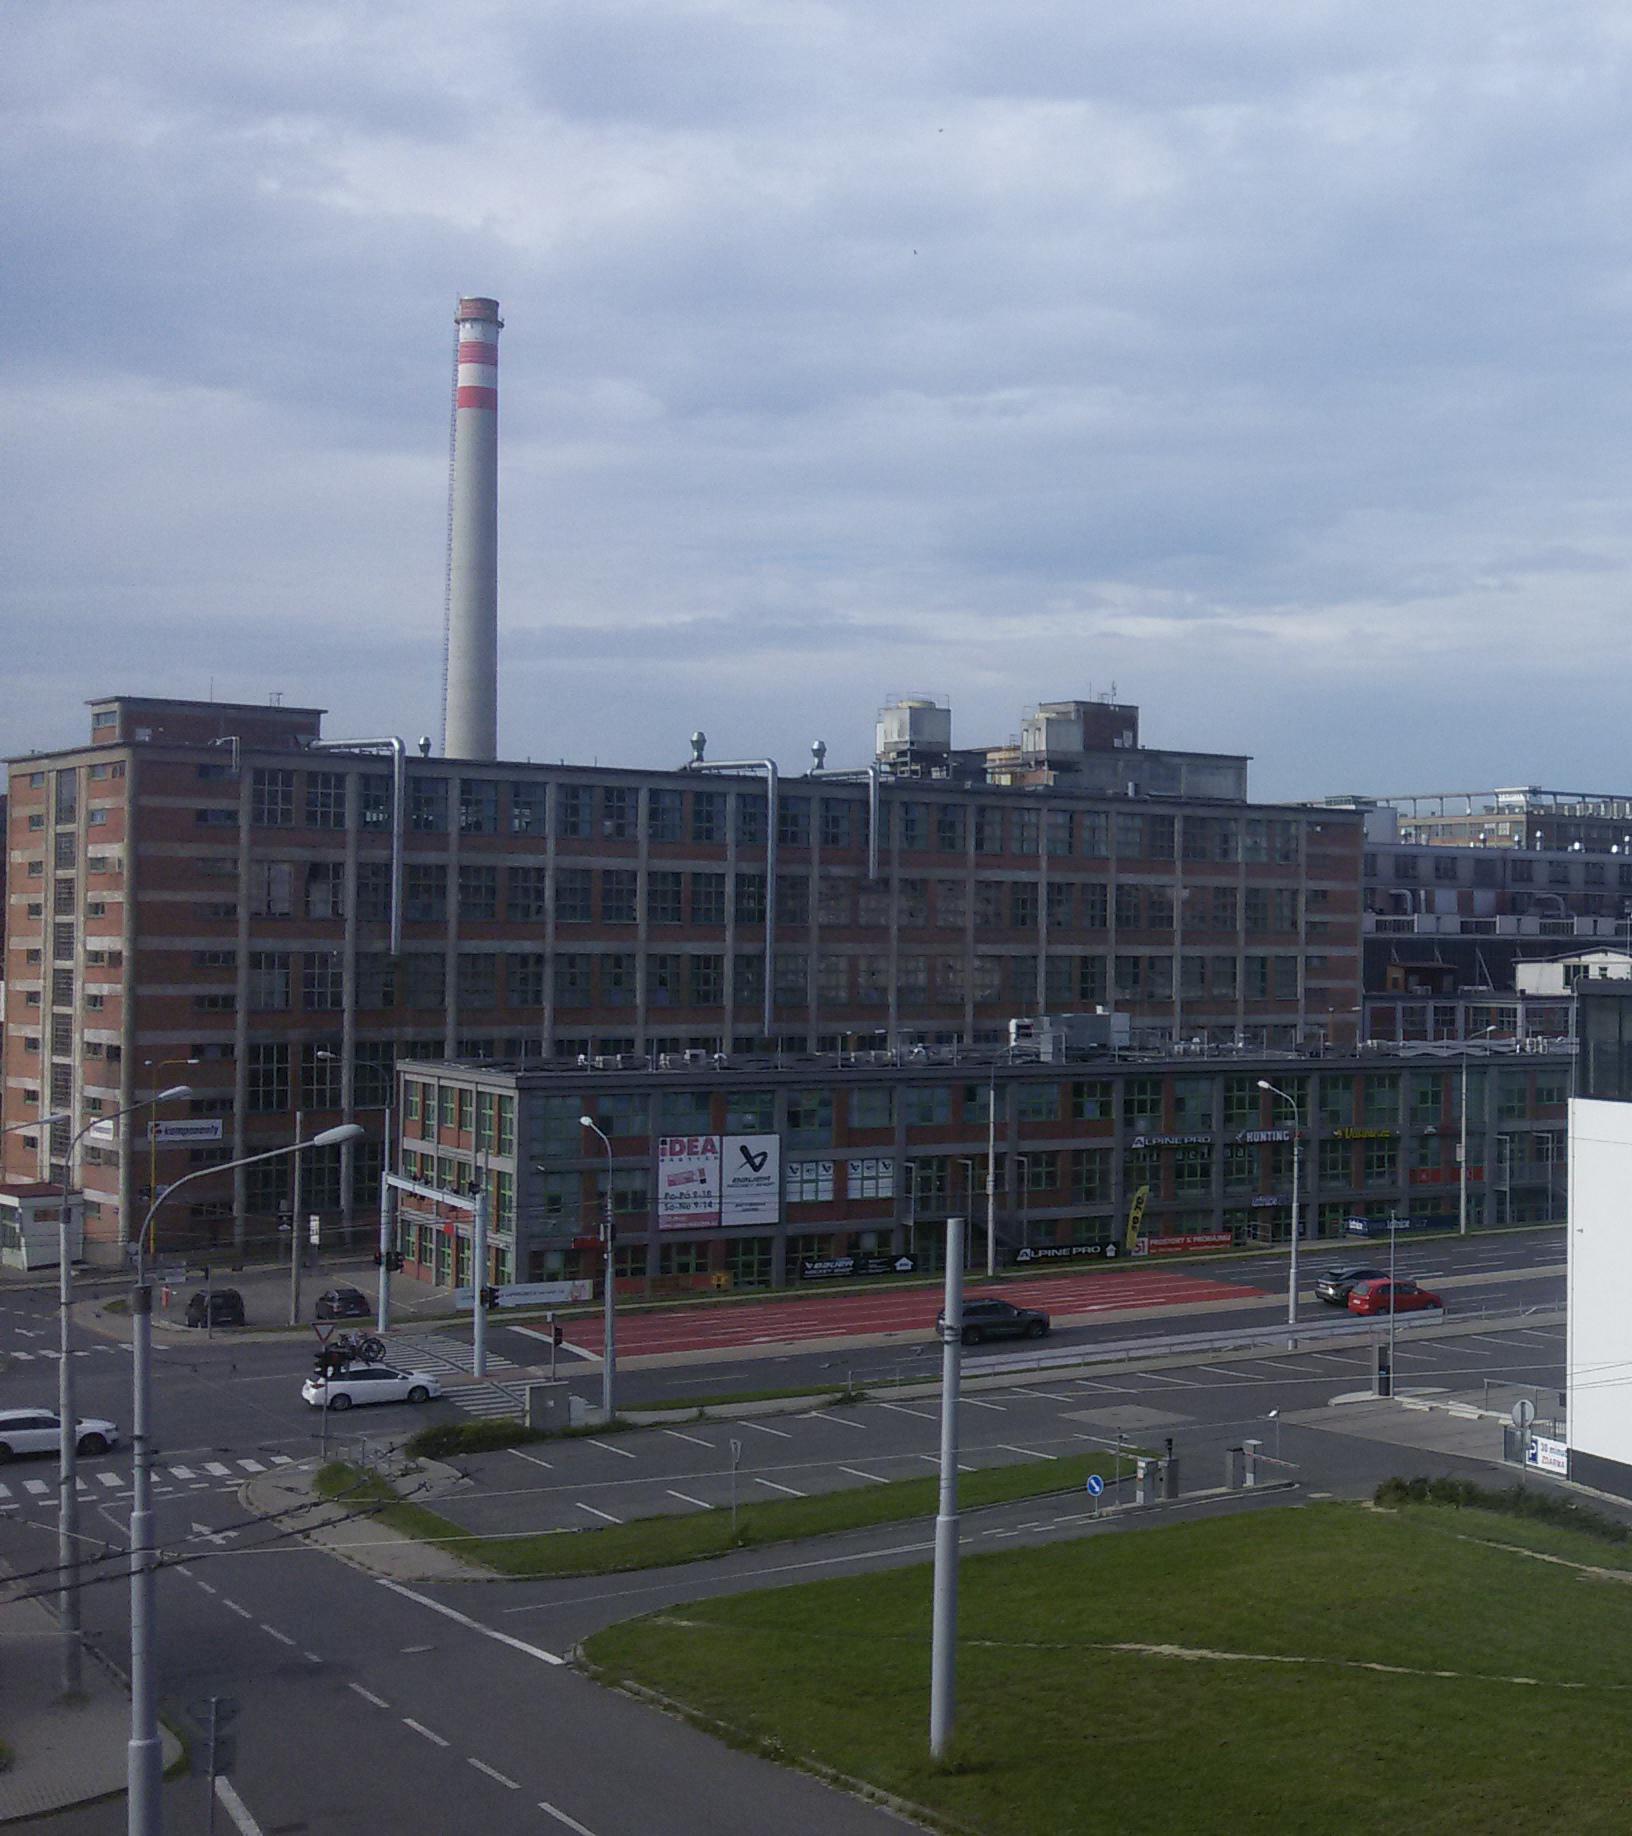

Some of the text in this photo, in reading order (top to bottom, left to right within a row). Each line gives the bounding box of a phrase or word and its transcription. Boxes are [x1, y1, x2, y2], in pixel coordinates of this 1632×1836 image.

[1131, 1135, 1211, 1149] ALPINE PRO
[1246, 1130, 1290, 1143] HUNTING
[1016, 1245, 1101, 1261] ALPINE PRO
